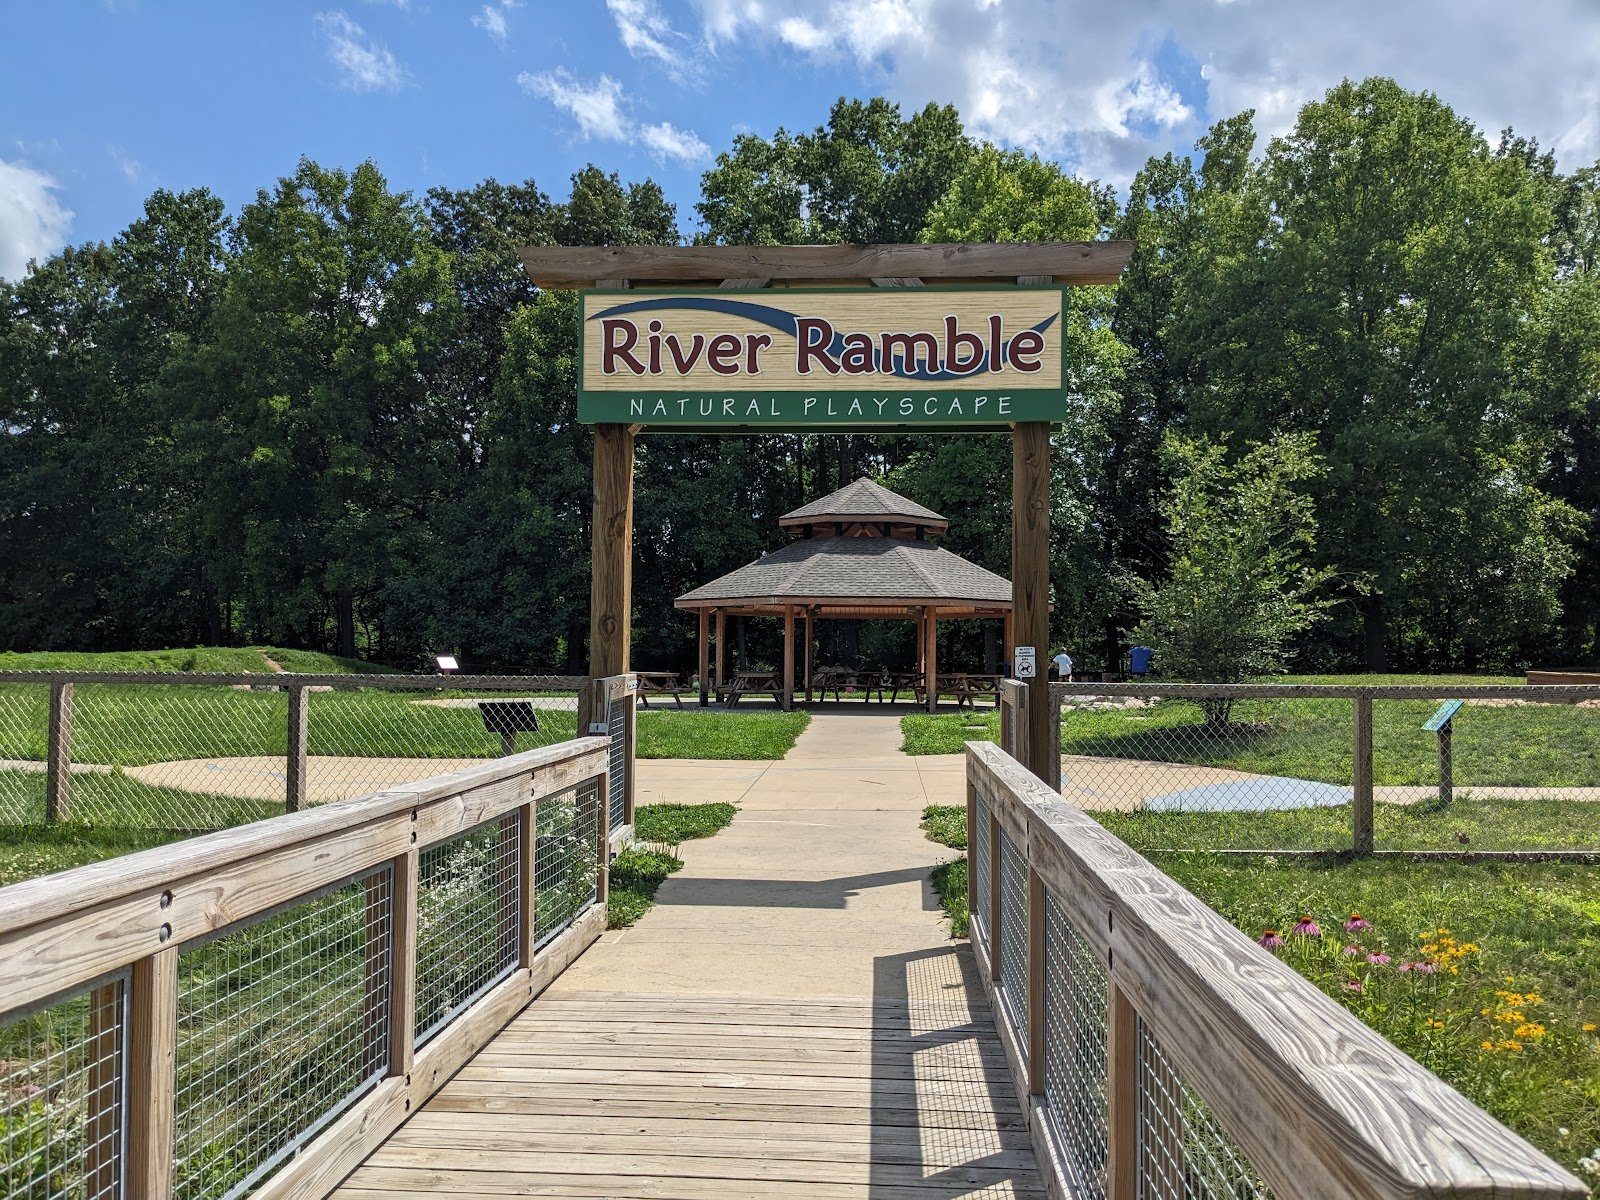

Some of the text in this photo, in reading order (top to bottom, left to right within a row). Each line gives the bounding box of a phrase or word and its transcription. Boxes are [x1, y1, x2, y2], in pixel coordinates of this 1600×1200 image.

[599, 314, 1045, 376] River Ramble
[630, 396, 1012, 416] NATURAL PLAYSCAPE
